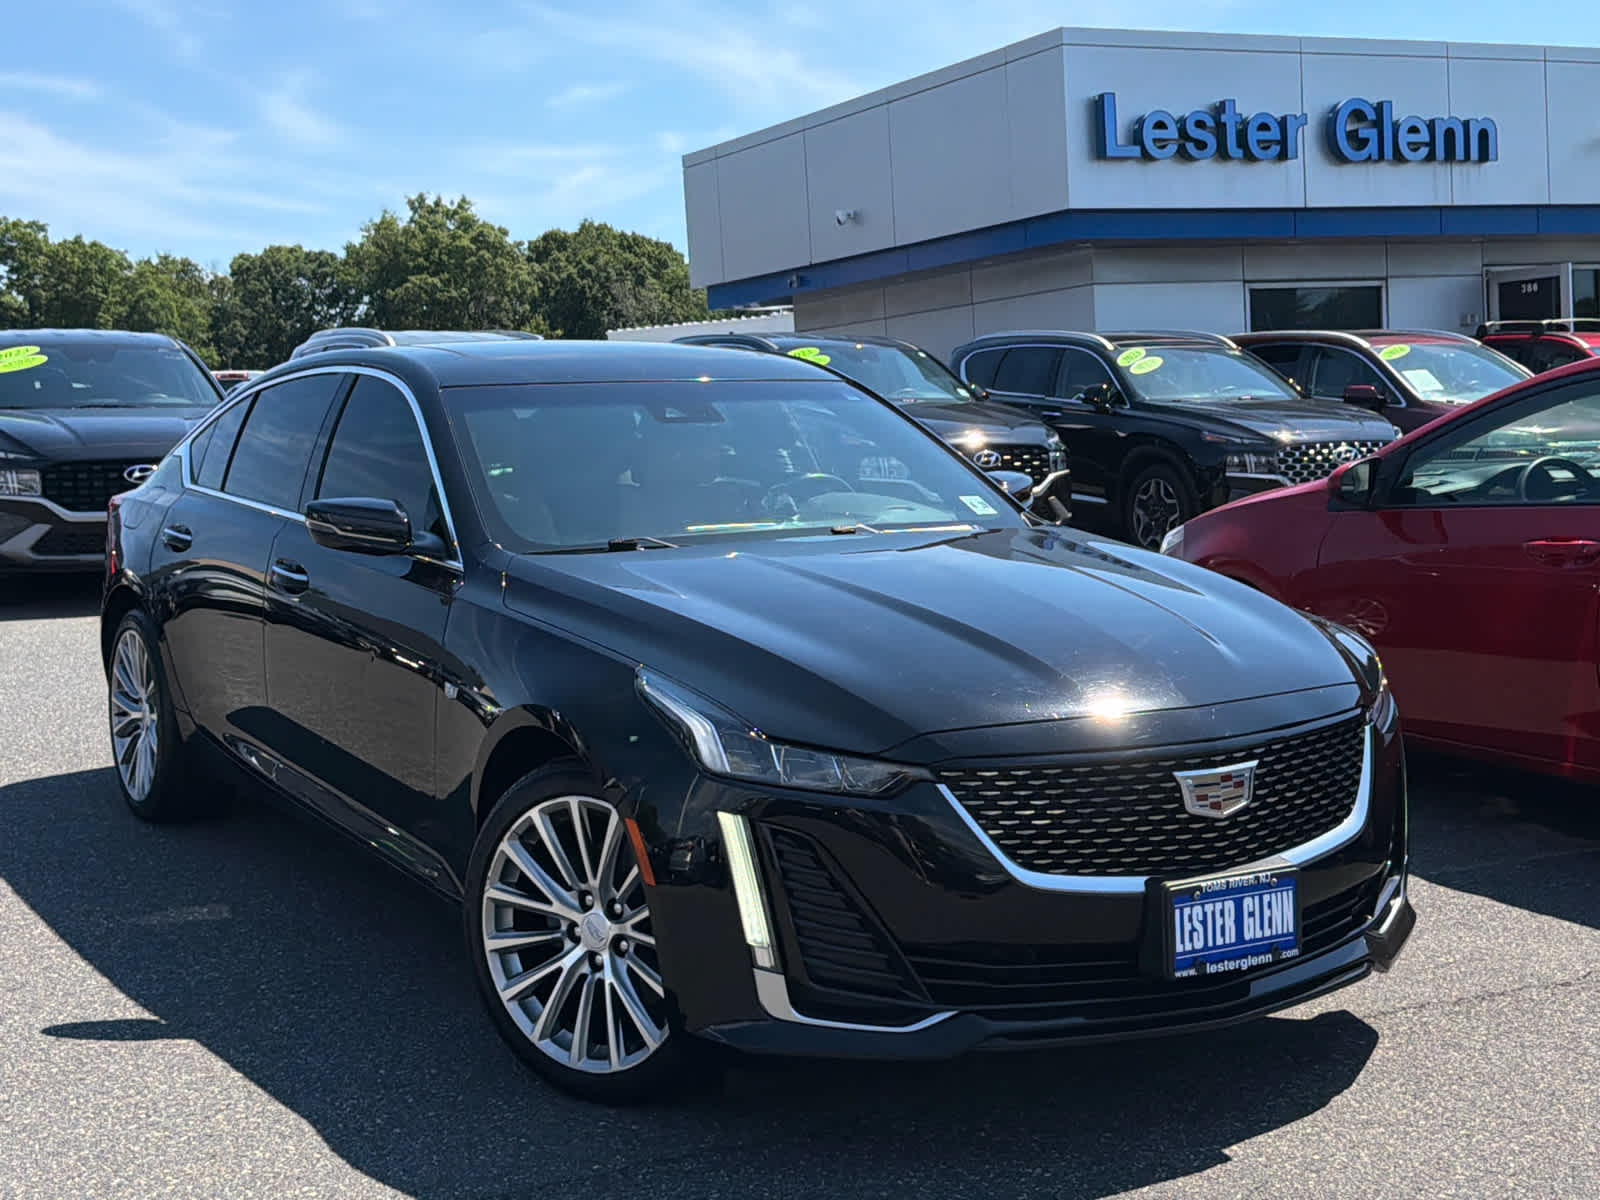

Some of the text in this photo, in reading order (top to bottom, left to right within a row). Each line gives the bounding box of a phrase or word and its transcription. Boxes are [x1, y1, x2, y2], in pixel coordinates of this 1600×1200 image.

[1098, 92, 1498, 162] Lester Glenn
[1200, 882, 1227, 894] TOMS
[1259, 873, 1271, 885] NJ
[1174, 890, 1294, 953] LESTER GLENN
[1206, 953, 1272, 974] lesterglenn
